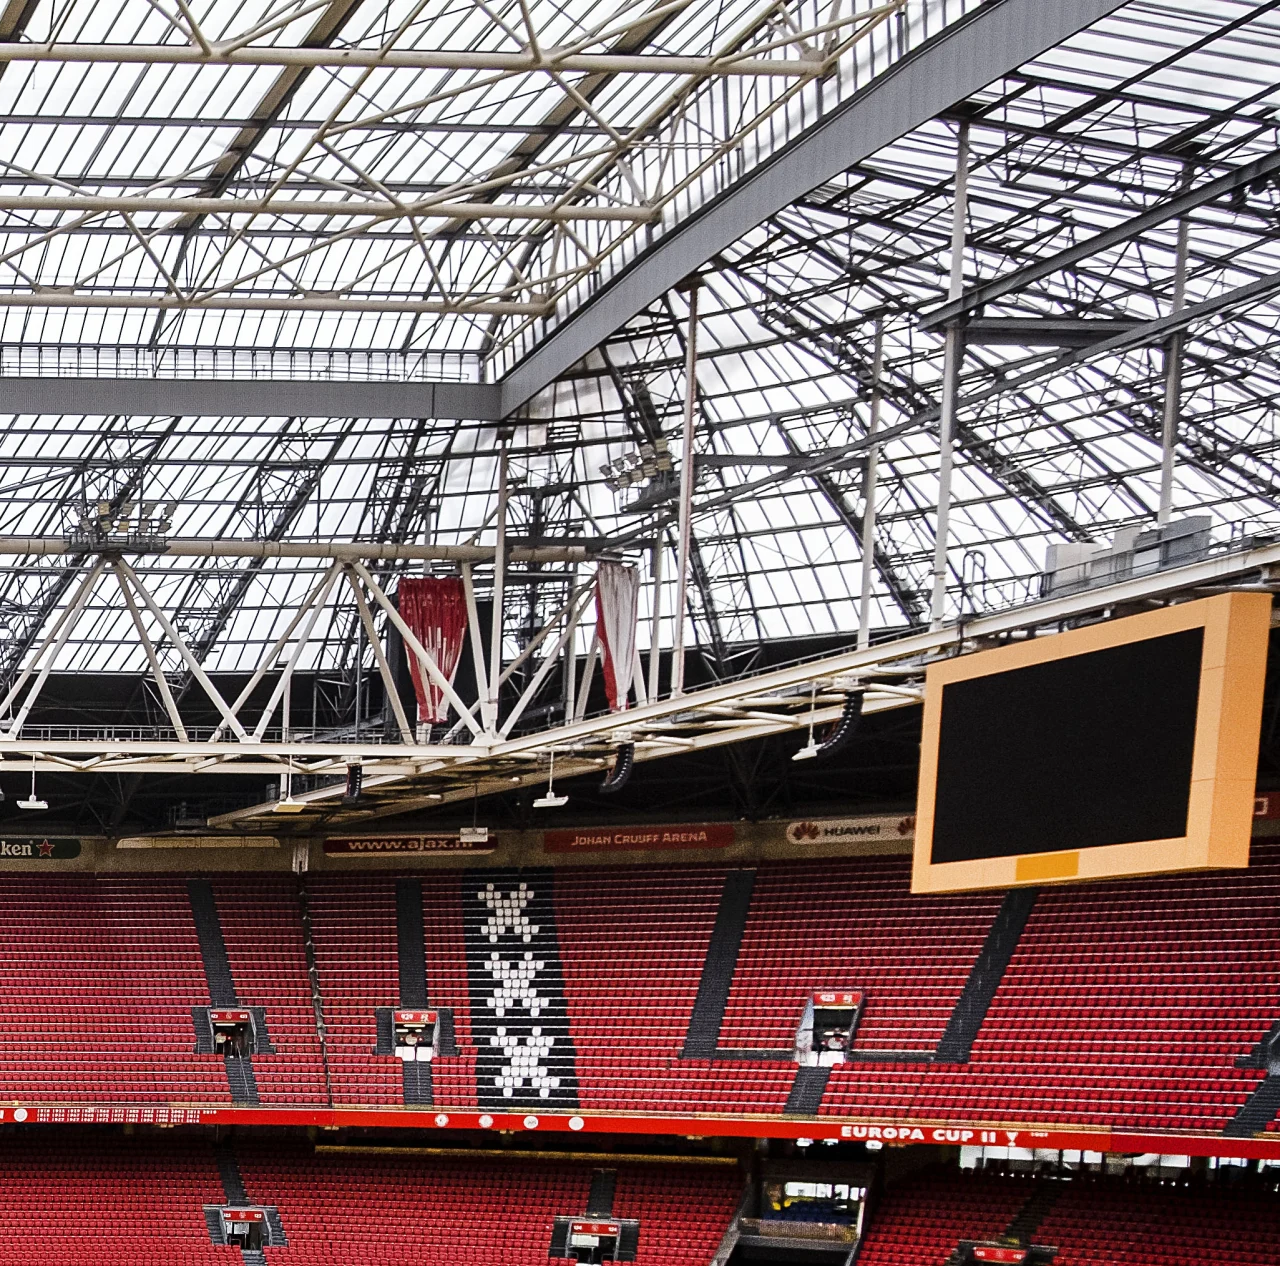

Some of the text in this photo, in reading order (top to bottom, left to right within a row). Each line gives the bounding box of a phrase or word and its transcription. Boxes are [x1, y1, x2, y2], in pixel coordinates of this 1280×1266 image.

[824, 825, 880, 836] HUAWEI
[571, 835, 612, 846] JOHAN
[841, 1126, 996, 1143] EUROPA CUP II
